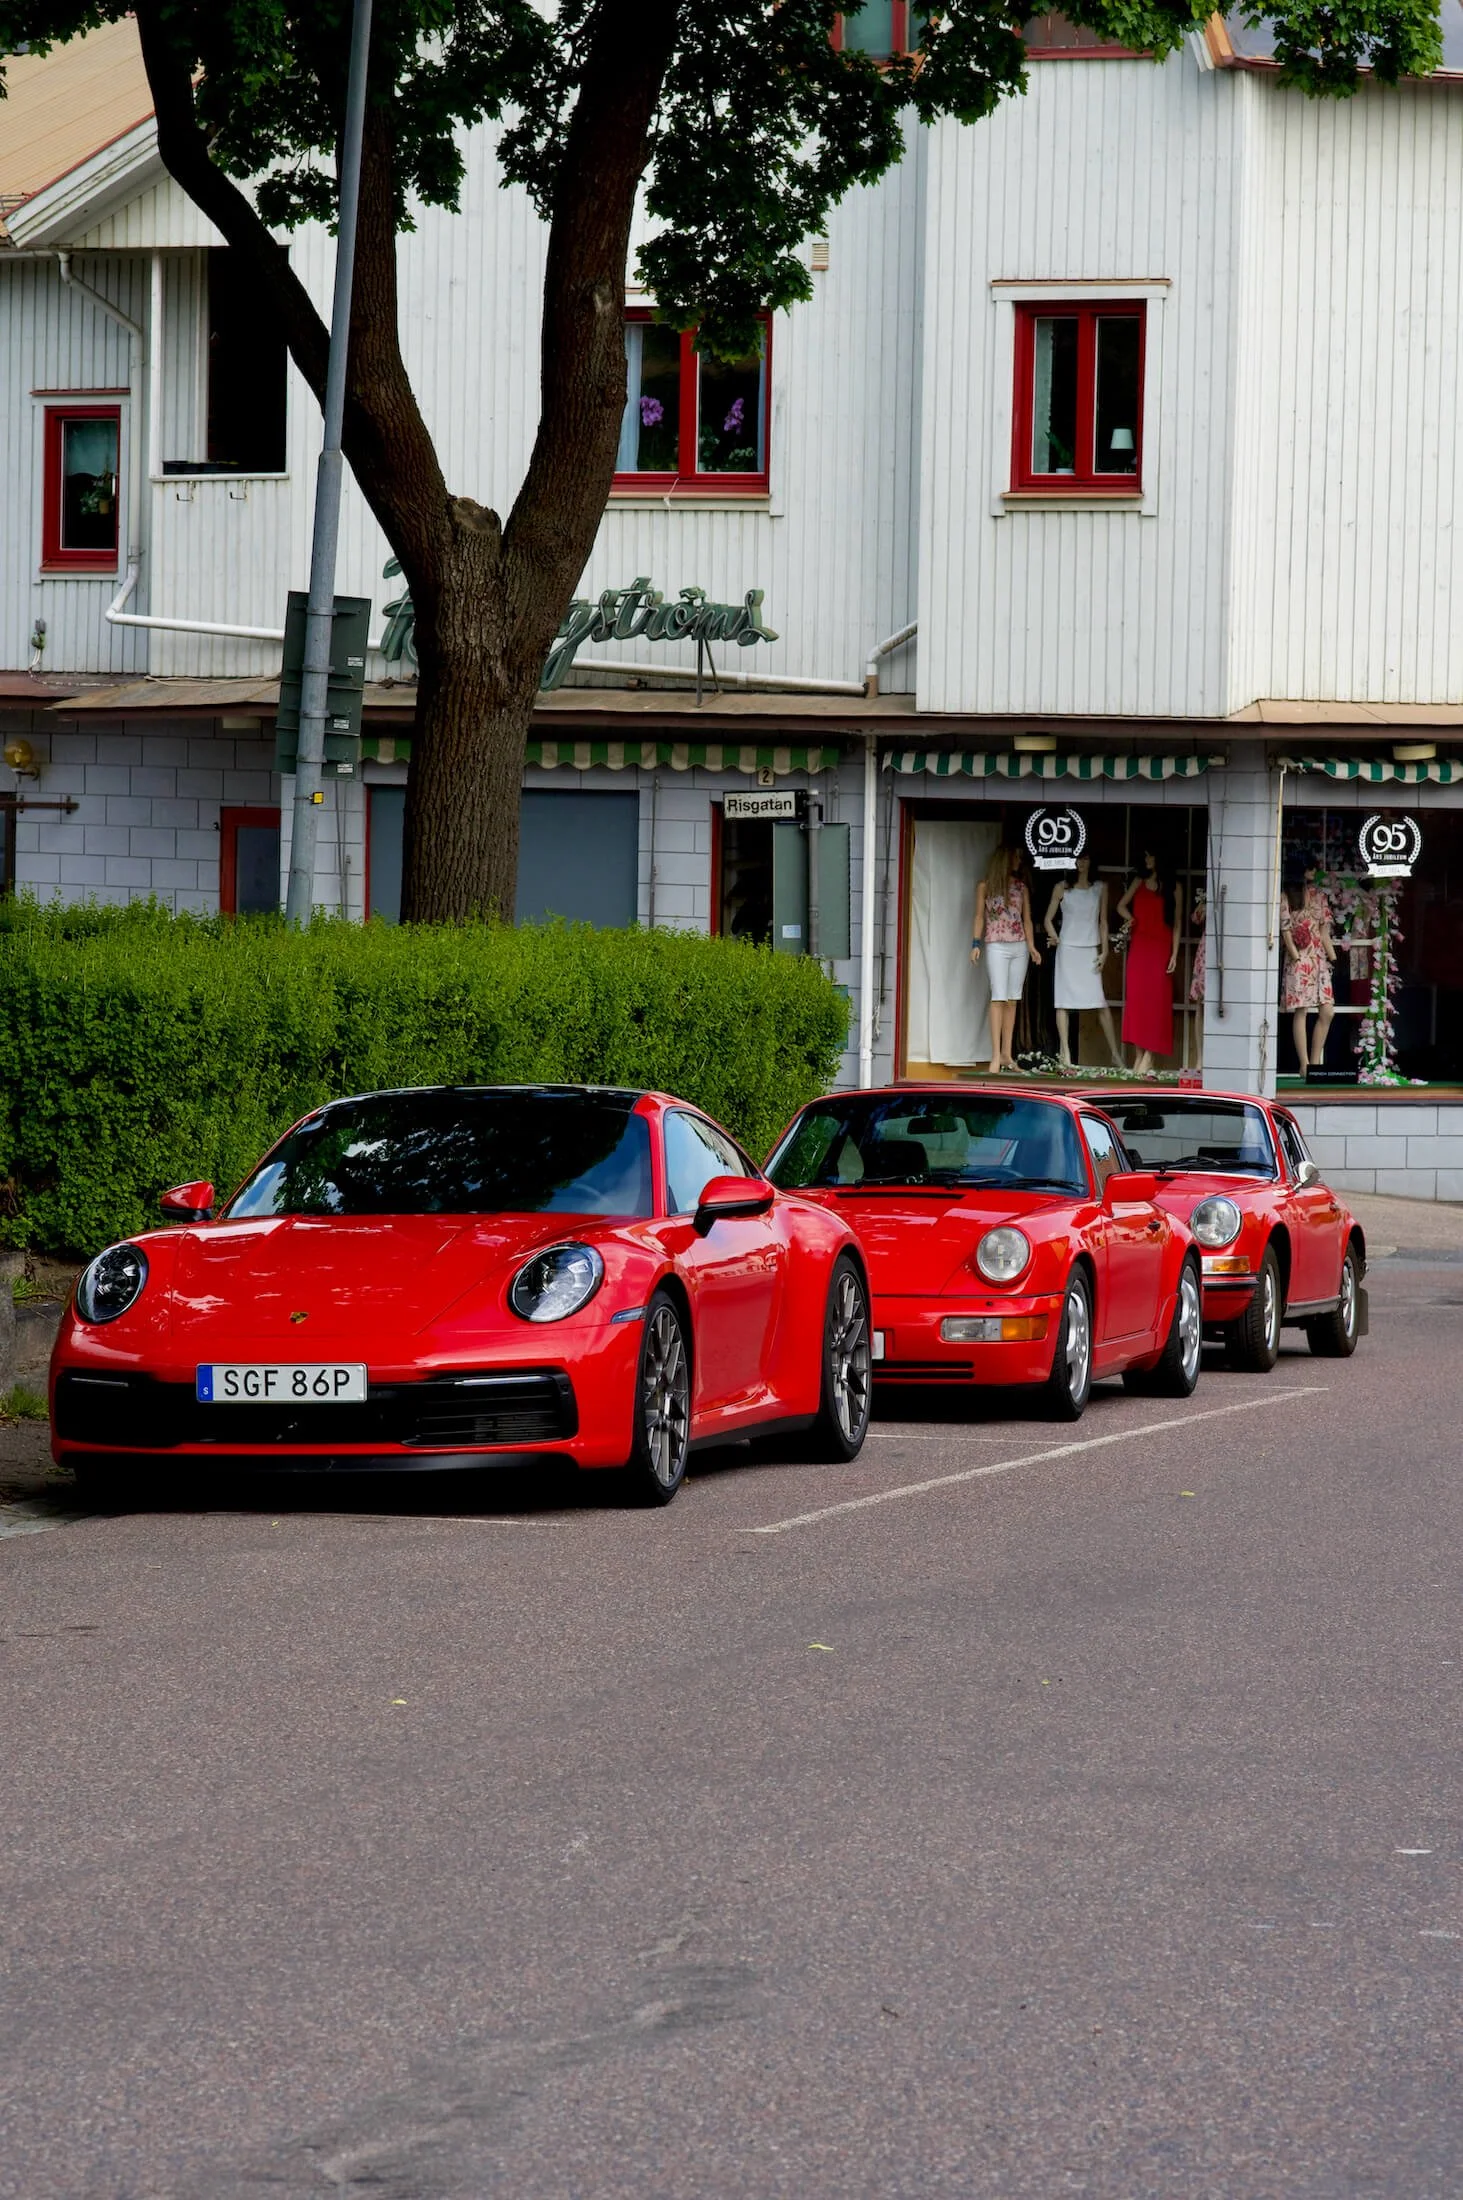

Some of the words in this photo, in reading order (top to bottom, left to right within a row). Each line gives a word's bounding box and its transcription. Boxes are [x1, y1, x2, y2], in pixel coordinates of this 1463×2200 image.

[762, 769, 770, 783] 2
[727, 798, 792, 814] Risgatan
[1037, 816, 1072, 846] 95
[1371, 823, 1407, 853] 95
[202, 1386, 209, 1396] S
[224, 1369, 279, 1397] SGF
[291, 1369, 350, 1397] 86P
